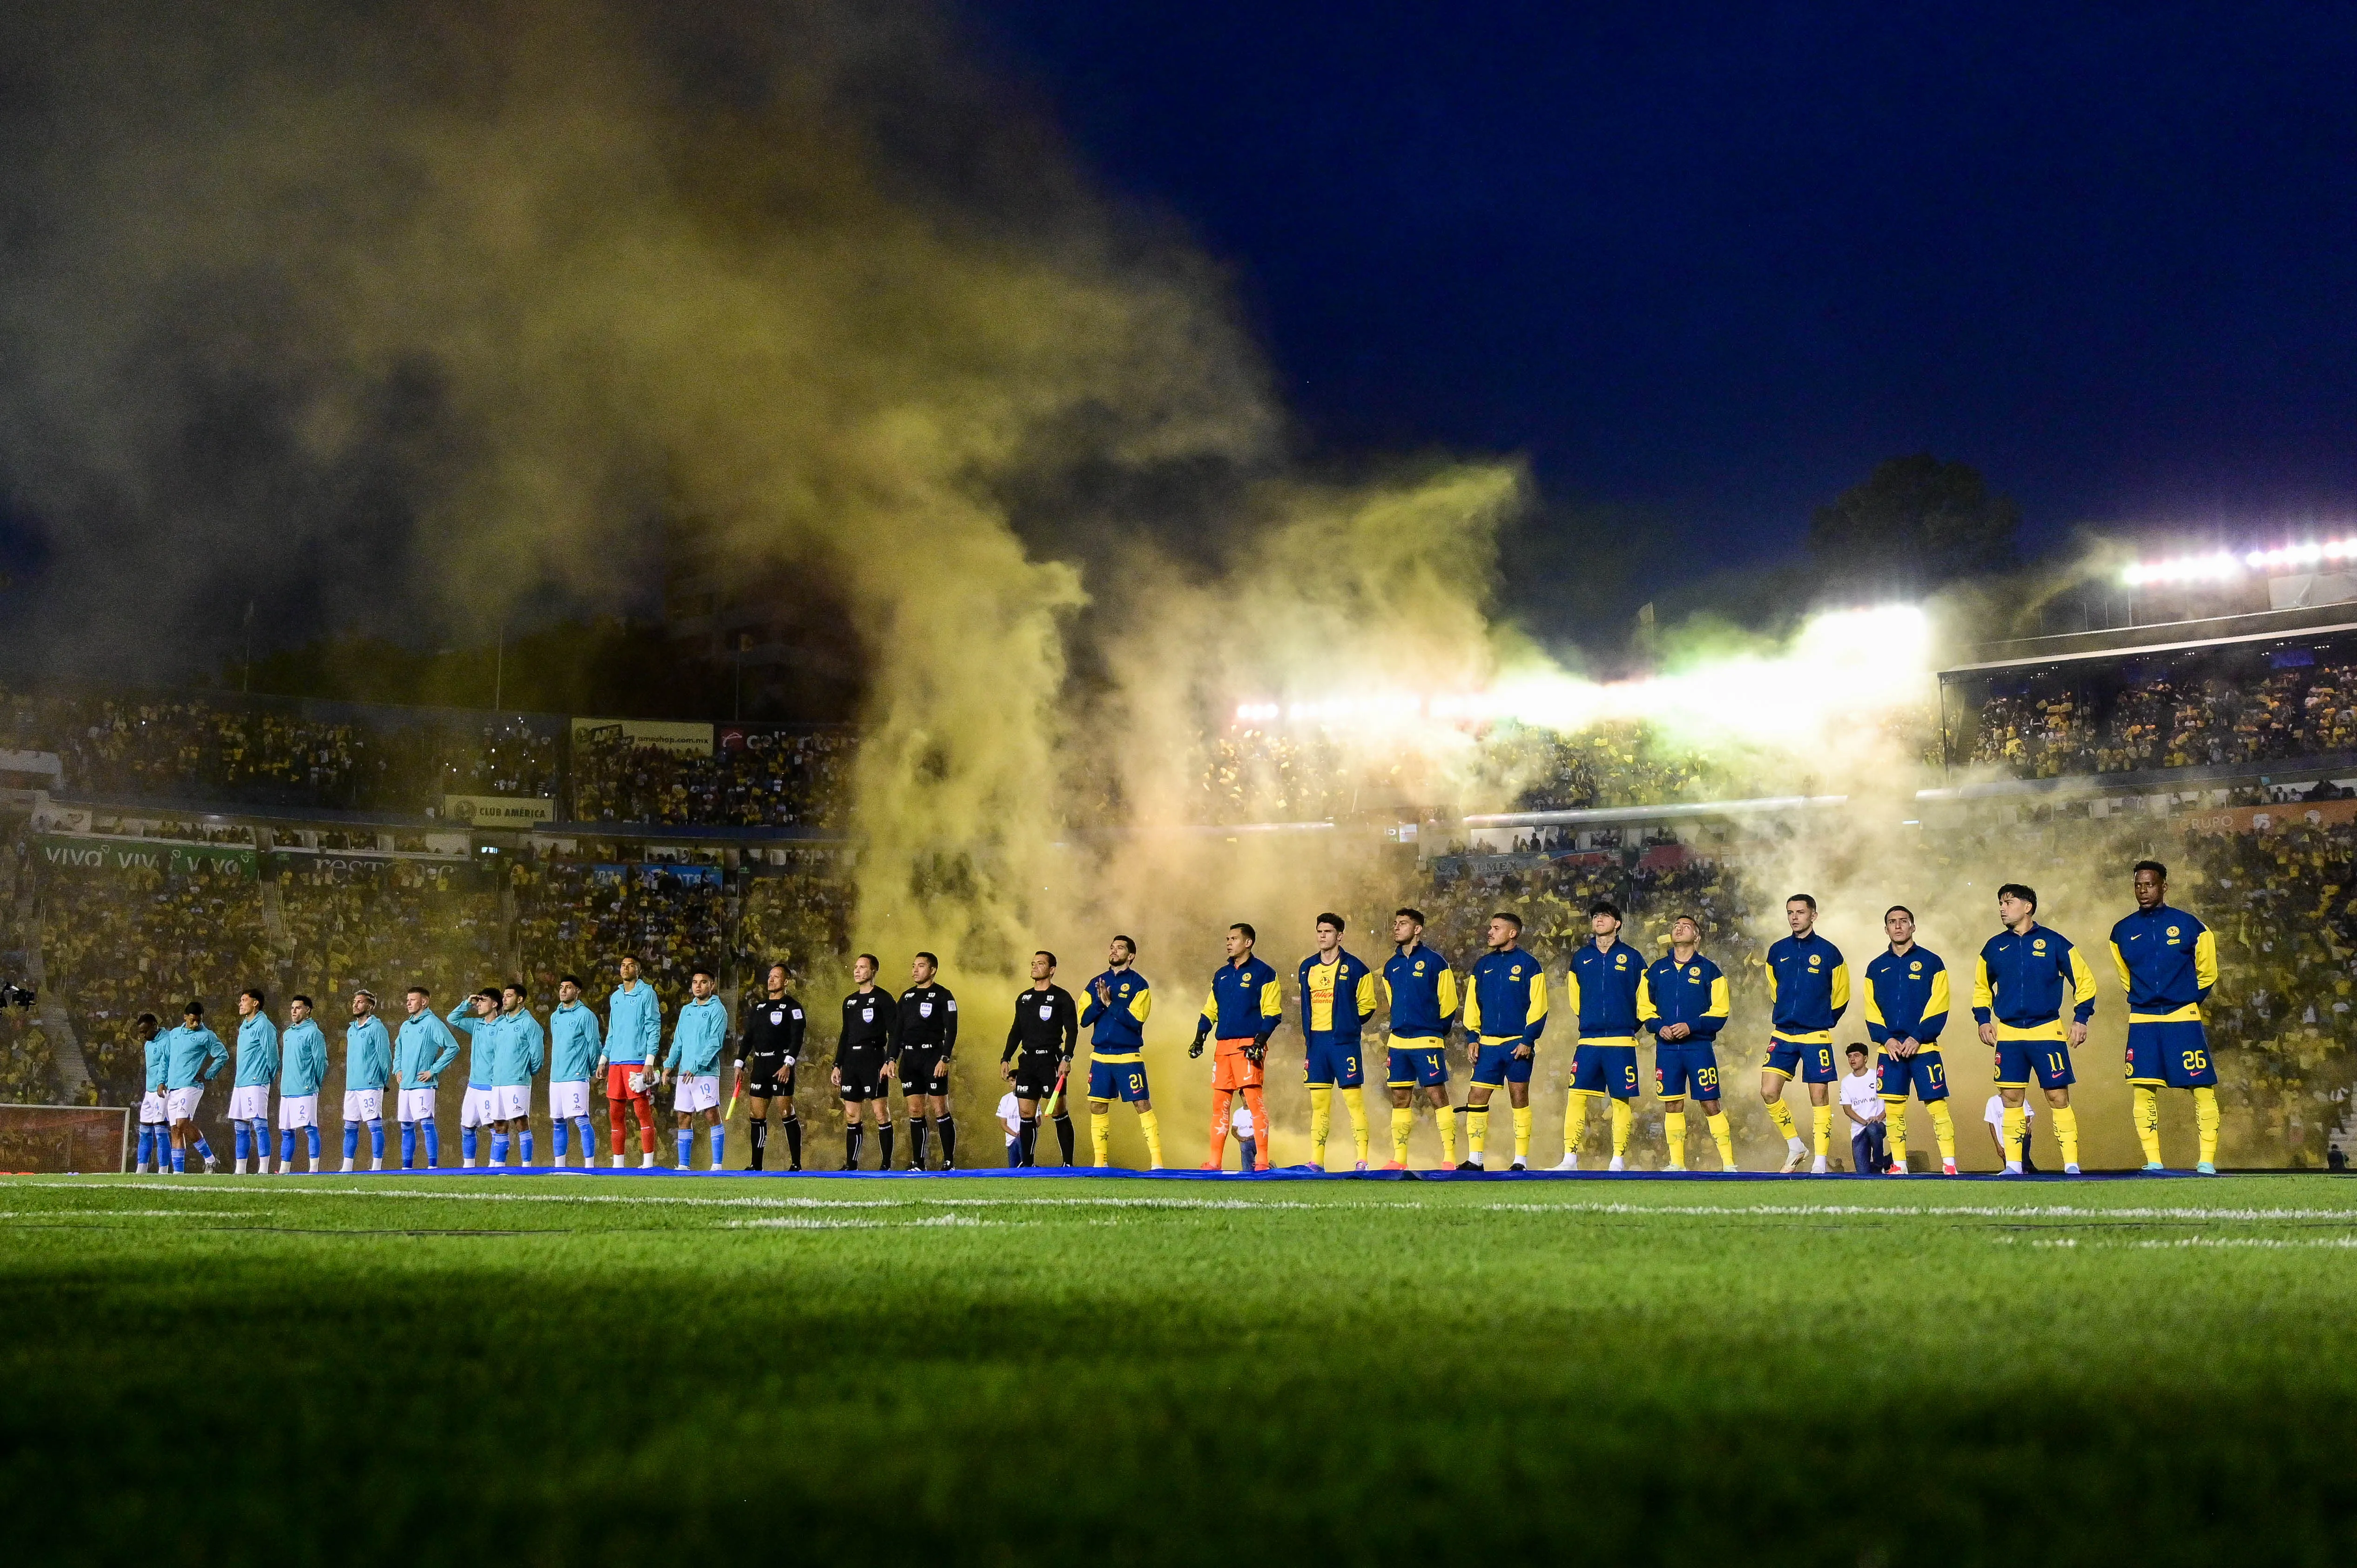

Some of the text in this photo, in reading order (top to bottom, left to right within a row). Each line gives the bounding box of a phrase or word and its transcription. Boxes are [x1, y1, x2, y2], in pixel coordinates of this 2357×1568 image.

[638, 736, 708, 744] ameshop.com.mx
[479, 807, 545, 818] CLUB AMÉRICA
[2180, 815, 2233, 830] GRUPO
[1426, 1054, 1440, 1070] 4
[1819, 1049, 1830, 1066] 8
[2047, 1052, 2064, 1072] 11
[2182, 1050, 2206, 1070] 26
[1347, 1057, 1356, 1072] 3
[1624, 1065, 1635, 1083] 5
[1697, 1067, 1717, 1086] 28
[1926, 1063, 1943, 1083] 17
[1129, 1073, 1144, 1089] 21
[700, 1083, 710, 1095] 19
[248, 1097, 252, 1106] 5
[363, 1097, 374, 1108] 33
[419, 1096, 424, 1106] 7
[512, 1094, 519, 1104] 6
[573, 1093, 579, 1104] 3
[155, 1102, 160, 1110] 4
[299, 1105, 304, 1115] 2
[485, 1100, 490, 1110] 8
